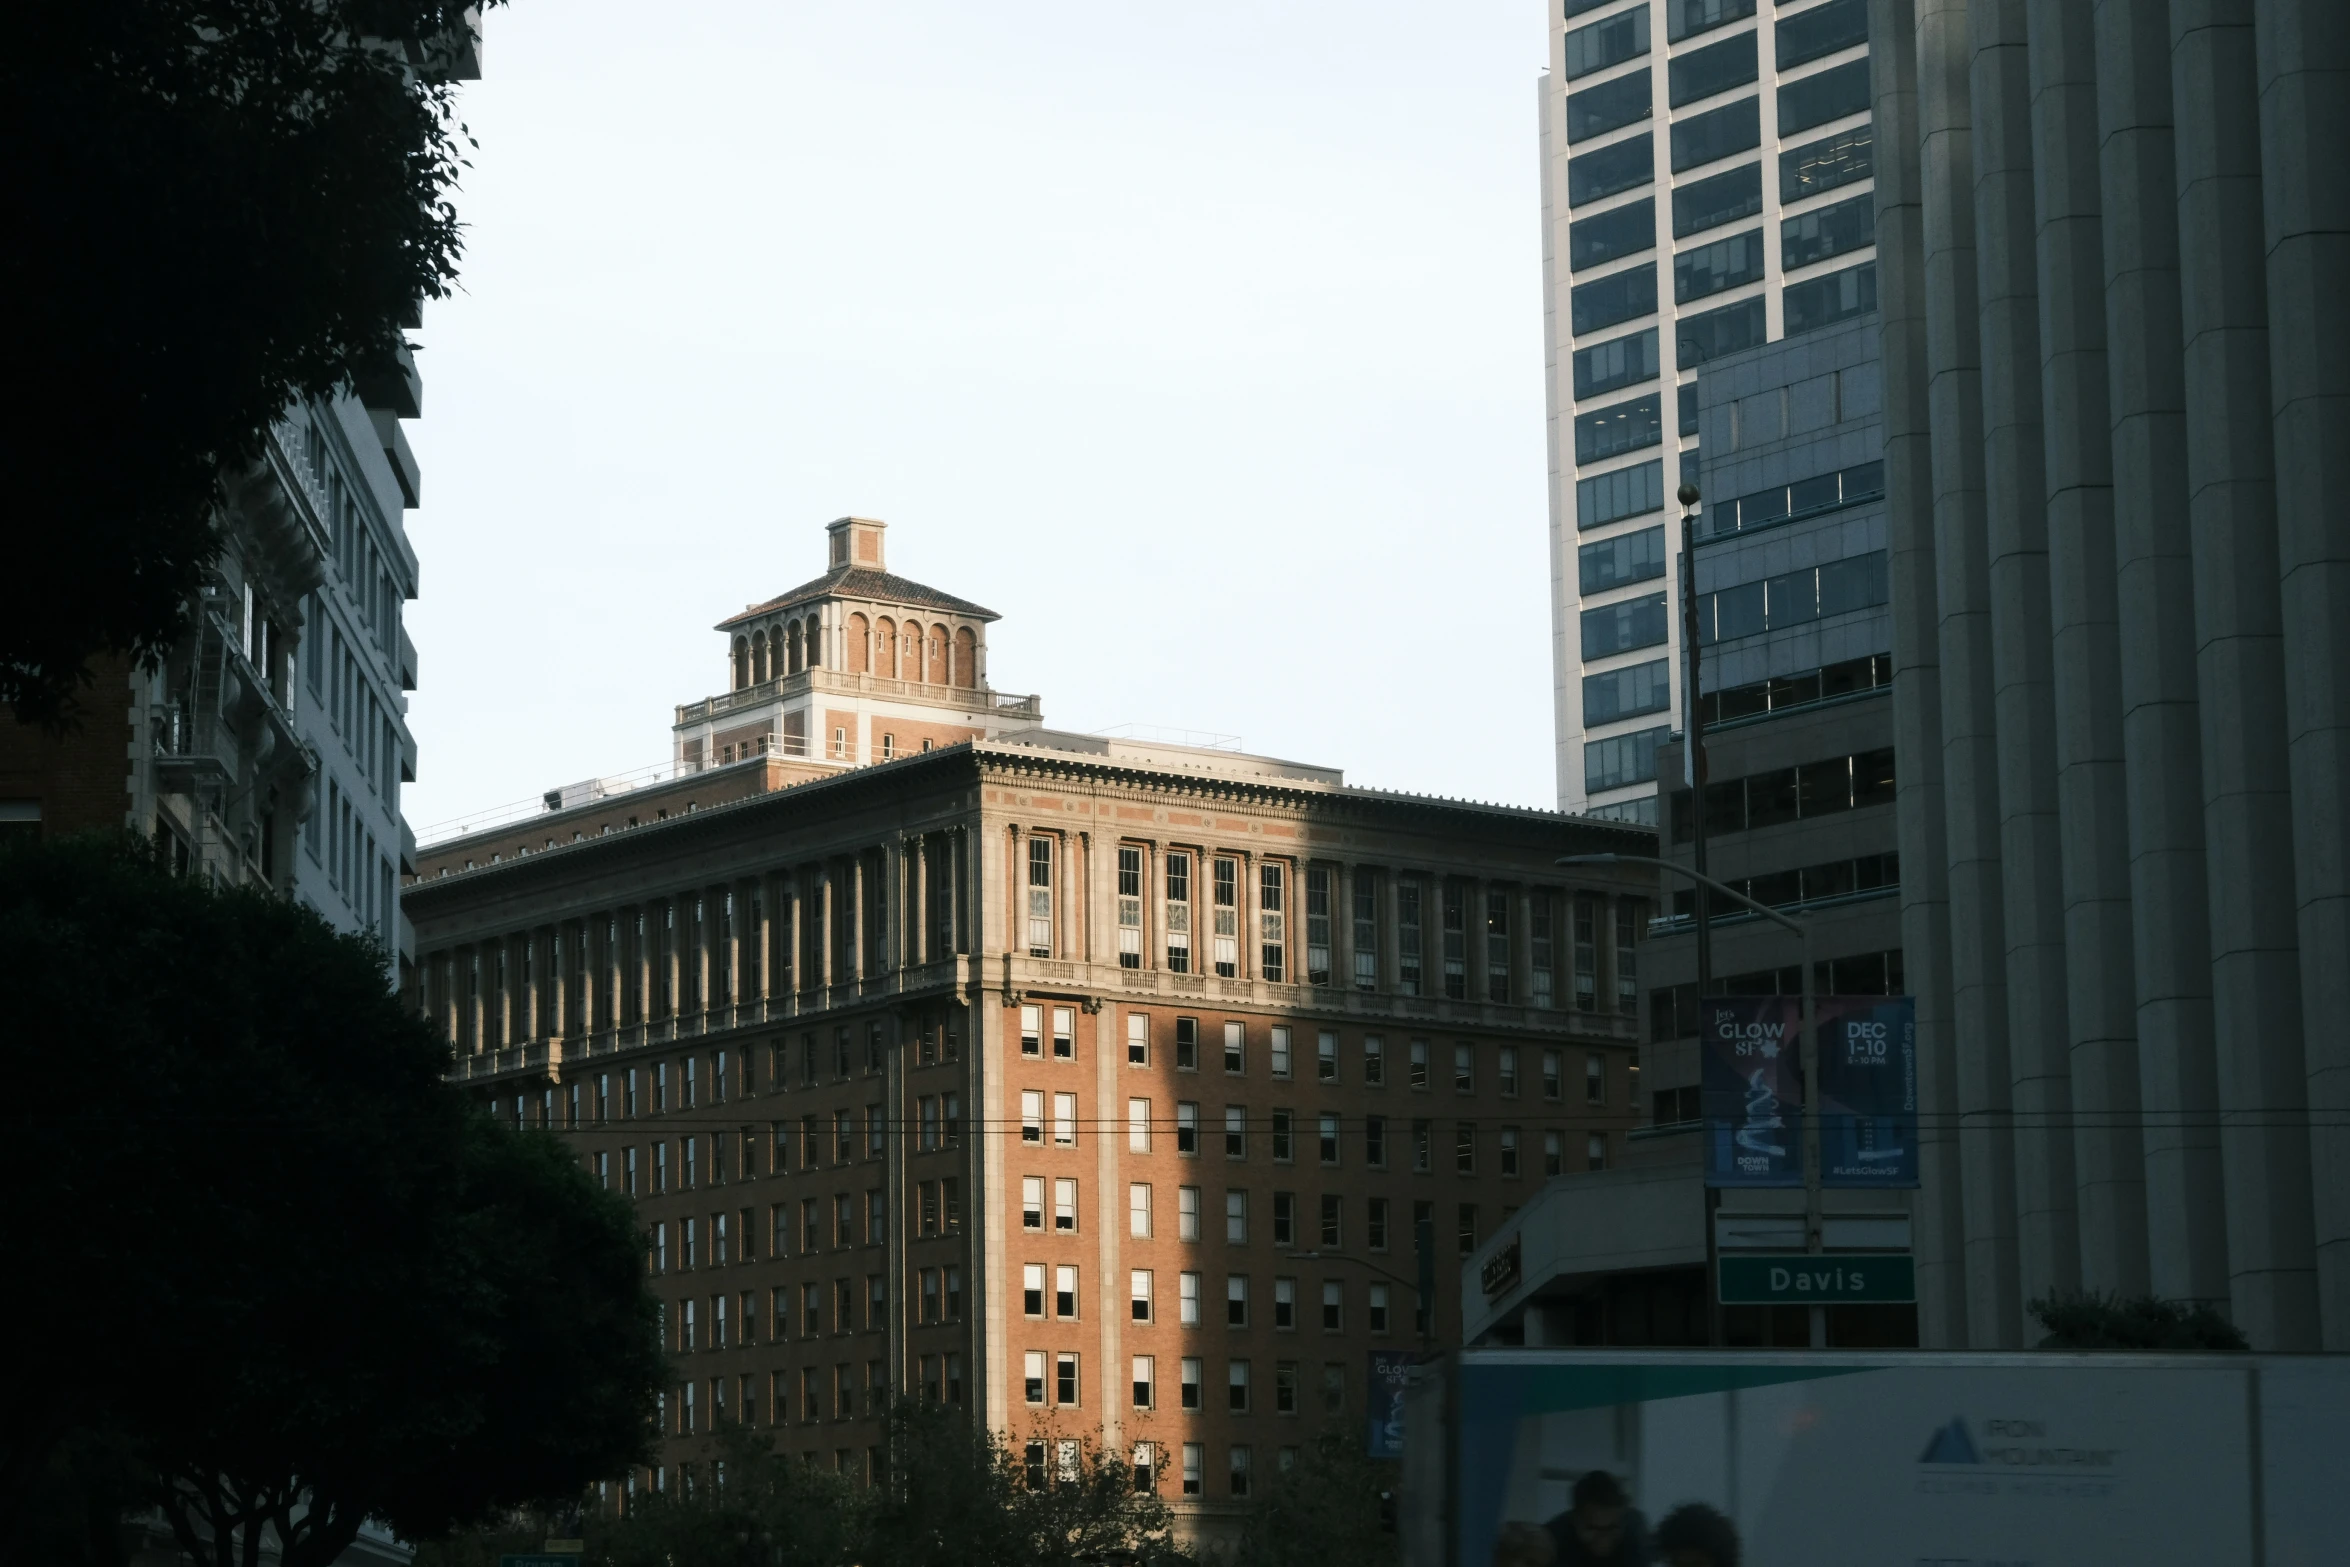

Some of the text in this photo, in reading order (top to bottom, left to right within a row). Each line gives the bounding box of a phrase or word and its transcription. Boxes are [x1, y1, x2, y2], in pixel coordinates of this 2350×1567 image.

[1713, 1008, 1735, 1025] Let's
[1718, 1022, 1786, 1039] GLOW
[1847, 1021, 1887, 1039] DEC
[1735, 1040, 1758, 1056] SF
[1847, 1039, 1887, 1056] 1-10
[1860, 1056, 1870, 1065] 10
[1871, 1056, 1886, 1065] PM
[1902, 1022, 1914, 1110] DowntownSF.org
[1737, 1156, 1769, 1165] DOWN
[1742, 1164, 1770, 1172] TOWN
[1833, 1166, 1899, 1176] #LetsGlowSF
[1769, 1267, 1865, 1291] Davis
